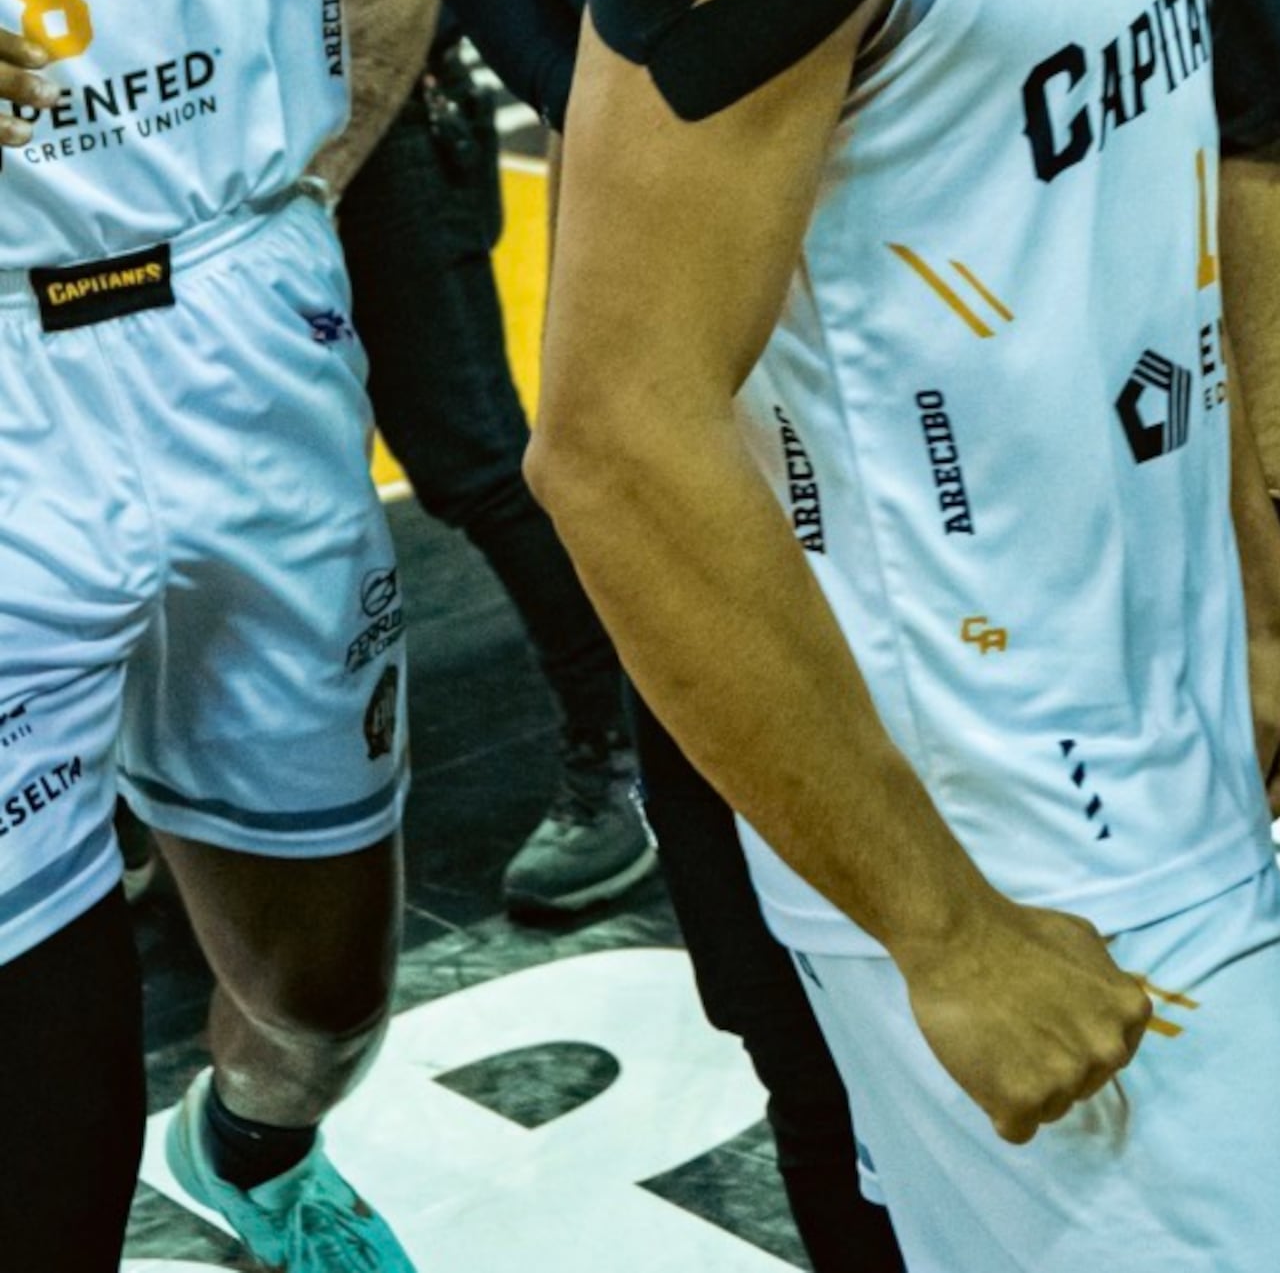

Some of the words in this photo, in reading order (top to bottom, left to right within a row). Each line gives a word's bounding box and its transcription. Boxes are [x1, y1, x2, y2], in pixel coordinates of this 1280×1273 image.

[24, 127, 125, 164] CREDIT
[136, 96, 217, 137] UNION
[47, 261, 163, 307] CAPITANES
[914, 389, 976, 536] ARECIBO
